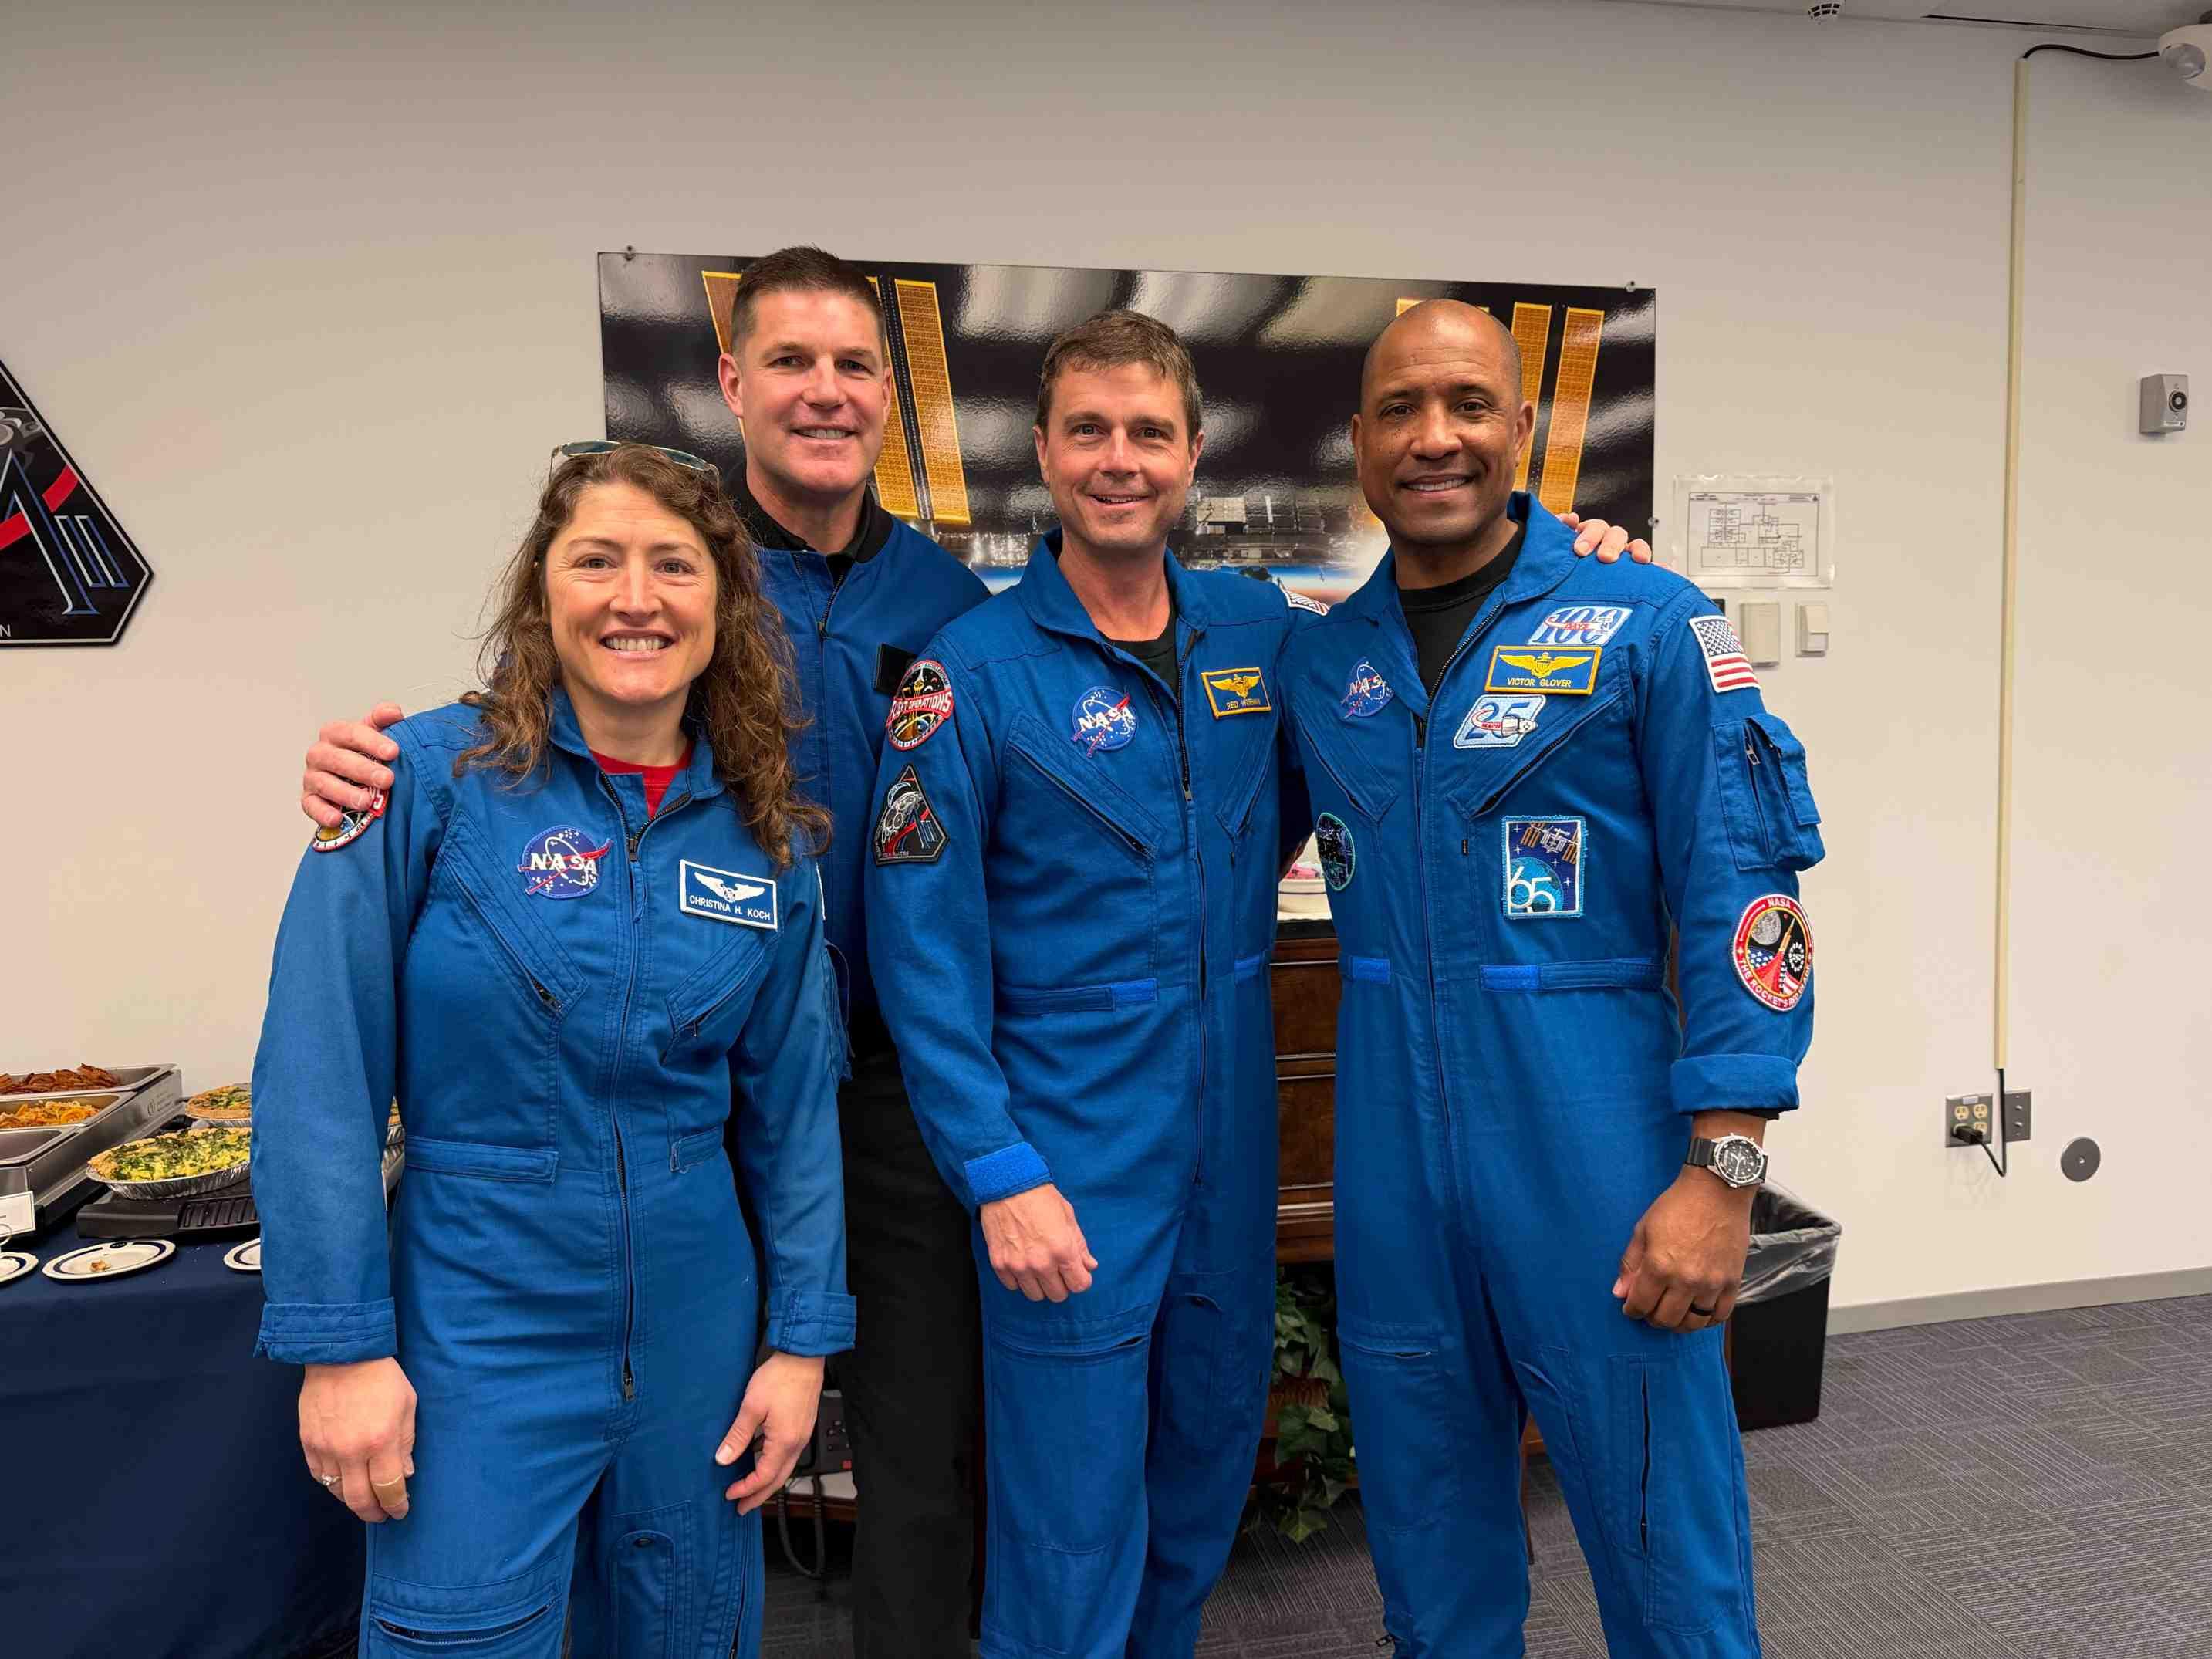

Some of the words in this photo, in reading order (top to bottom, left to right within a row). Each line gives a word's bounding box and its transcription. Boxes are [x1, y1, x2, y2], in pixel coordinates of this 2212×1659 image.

[1507, 677, 1535, 687] VICTOR
[1540, 677, 1572, 687] GLOVER
[909, 692, 952, 713] OPERATIONS
[1077, 705, 1135, 732] NASA
[1466, 701, 1530, 739] 25
[530, 853, 598, 877] NASA
[1509, 865, 1556, 912] 65
[689, 894, 731, 912] CHRISTINA
[735, 906, 743, 914] H.
[747, 907, 771, 921] KOCH
[1767, 897, 1791, 908] NASA
[1739, 959, 1752, 981] THE
